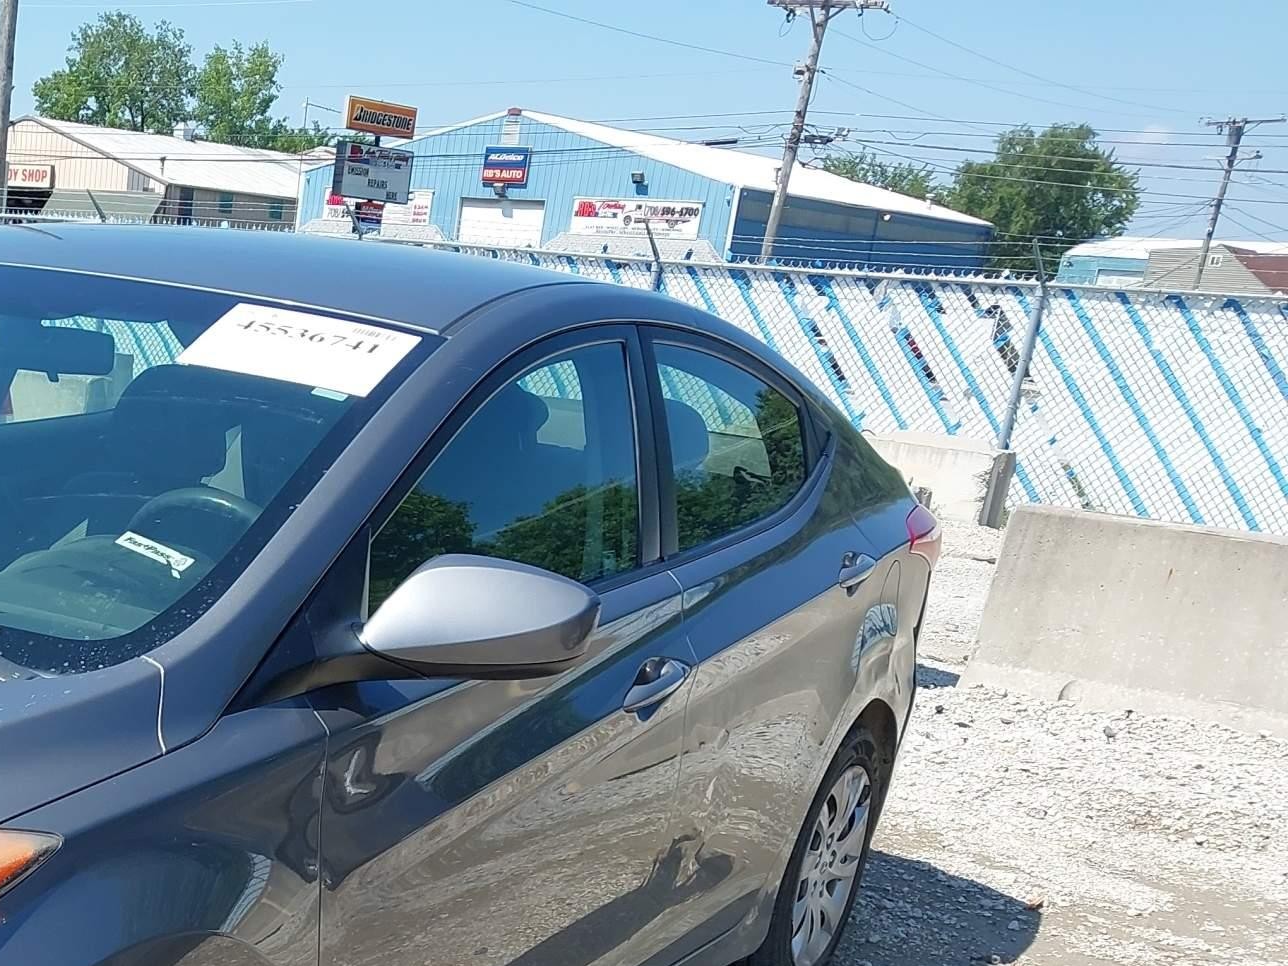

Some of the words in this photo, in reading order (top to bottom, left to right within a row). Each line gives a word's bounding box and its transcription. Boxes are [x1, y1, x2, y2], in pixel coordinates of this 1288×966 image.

[353, 105, 414, 131] BRIDGESTONE
[22, 169, 48, 182] SHOP
[501, 169, 523, 179] AUTO
[367, 178, 388, 189] REPAIRS
[386, 191, 398, 201] HERE
[237, 320, 380, 354] 45536741
